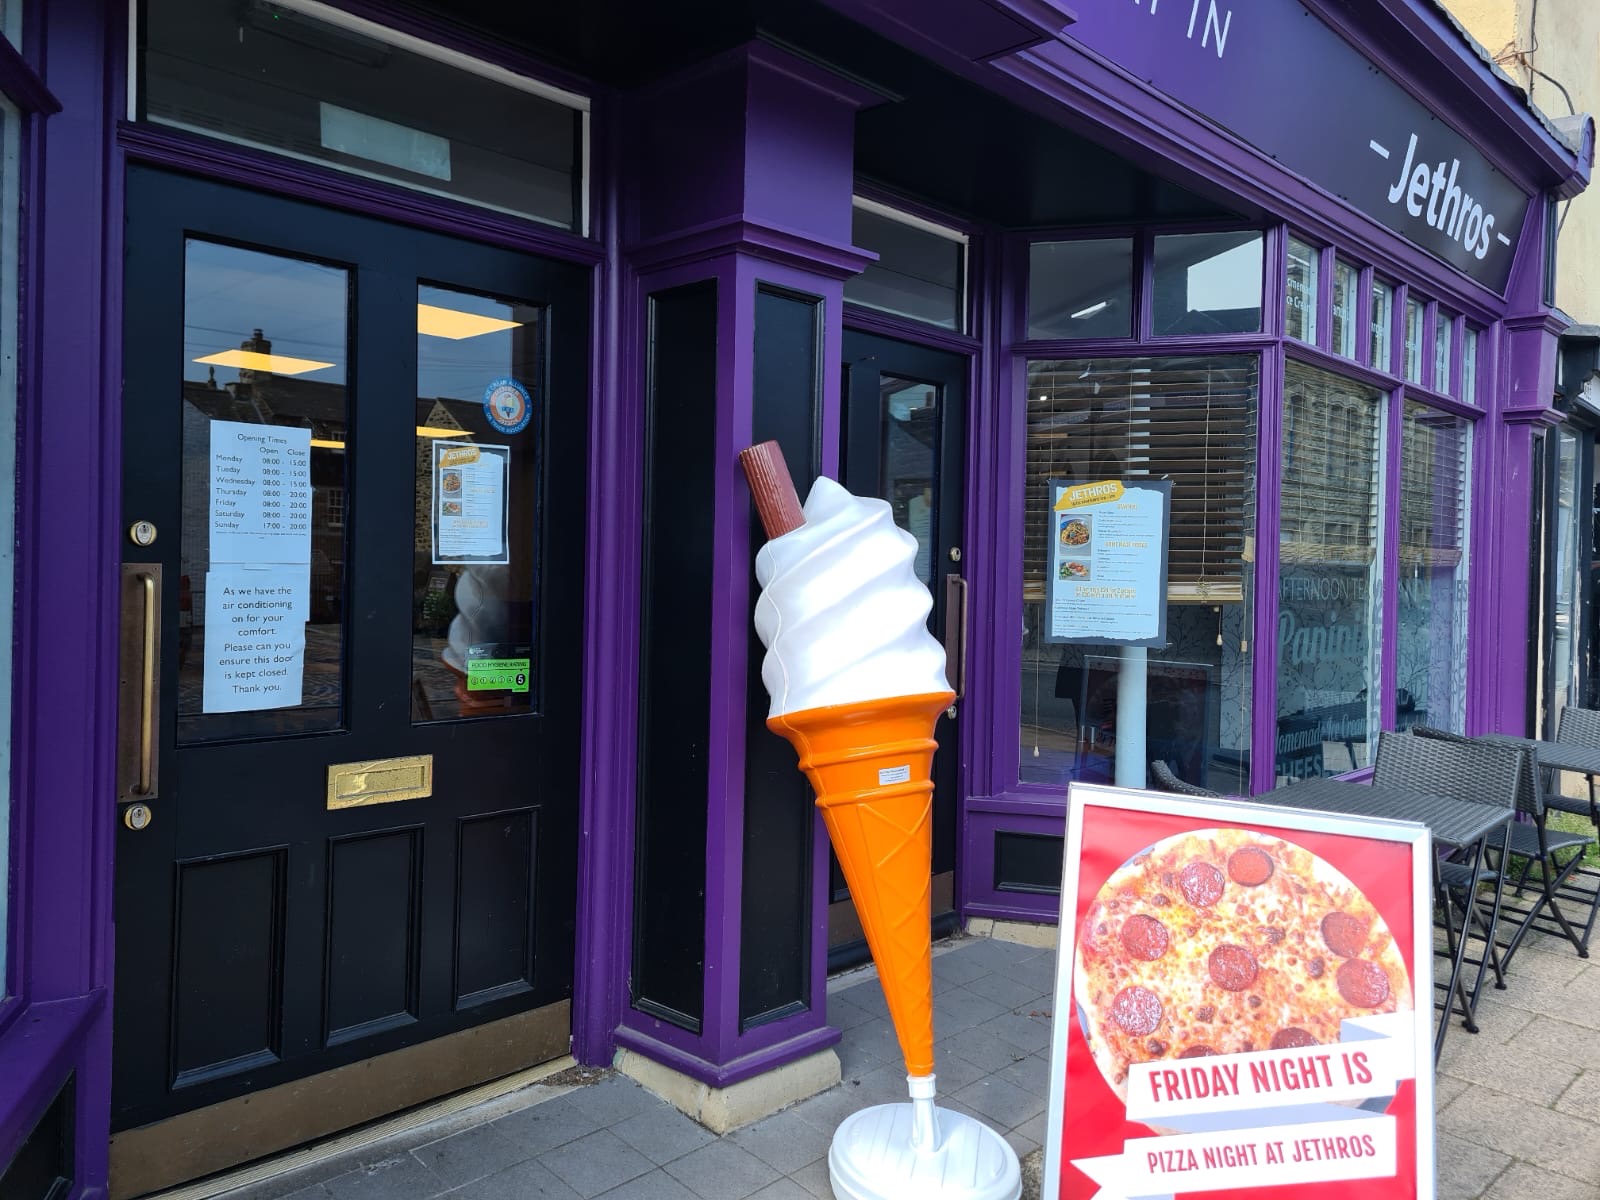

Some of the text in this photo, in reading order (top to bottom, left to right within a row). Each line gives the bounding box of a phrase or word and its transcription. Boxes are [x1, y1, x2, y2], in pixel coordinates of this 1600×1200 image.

[1388, 132, 1495, 260] Jethros
[237, 433, 287, 445] Opening Times
[260, 447, 306, 457] Open Close
[216, 454, 242, 463] Monday
[216, 476, 256, 487] Wednesday
[216, 487, 247, 497] Thursday
[1069, 483, 1117, 501] JETHROS
[215, 498, 236, 507] Friday
[215, 510, 245, 519] Saturday
[215, 521, 240, 529] Sunday
[223, 587, 235, 596] As
[254, 587, 275, 596] have
[278, 586, 292, 595] the
[222, 600, 293, 610] air conditioning
[246, 614, 260, 622] for
[262, 615, 284, 624] your
[224, 643, 253, 652] Please
[274, 643, 291, 652] you
[219, 655, 294, 666] ensure this door
[224, 672, 232, 680] is
[235, 671, 256, 680] kept
[232, 684, 260, 694] Thank
[1148, 1051, 1373, 1103] FRIDAY NIGHT IS
[1147, 1134, 1376, 1174] PIZZA NIGHT AT JETHROS
